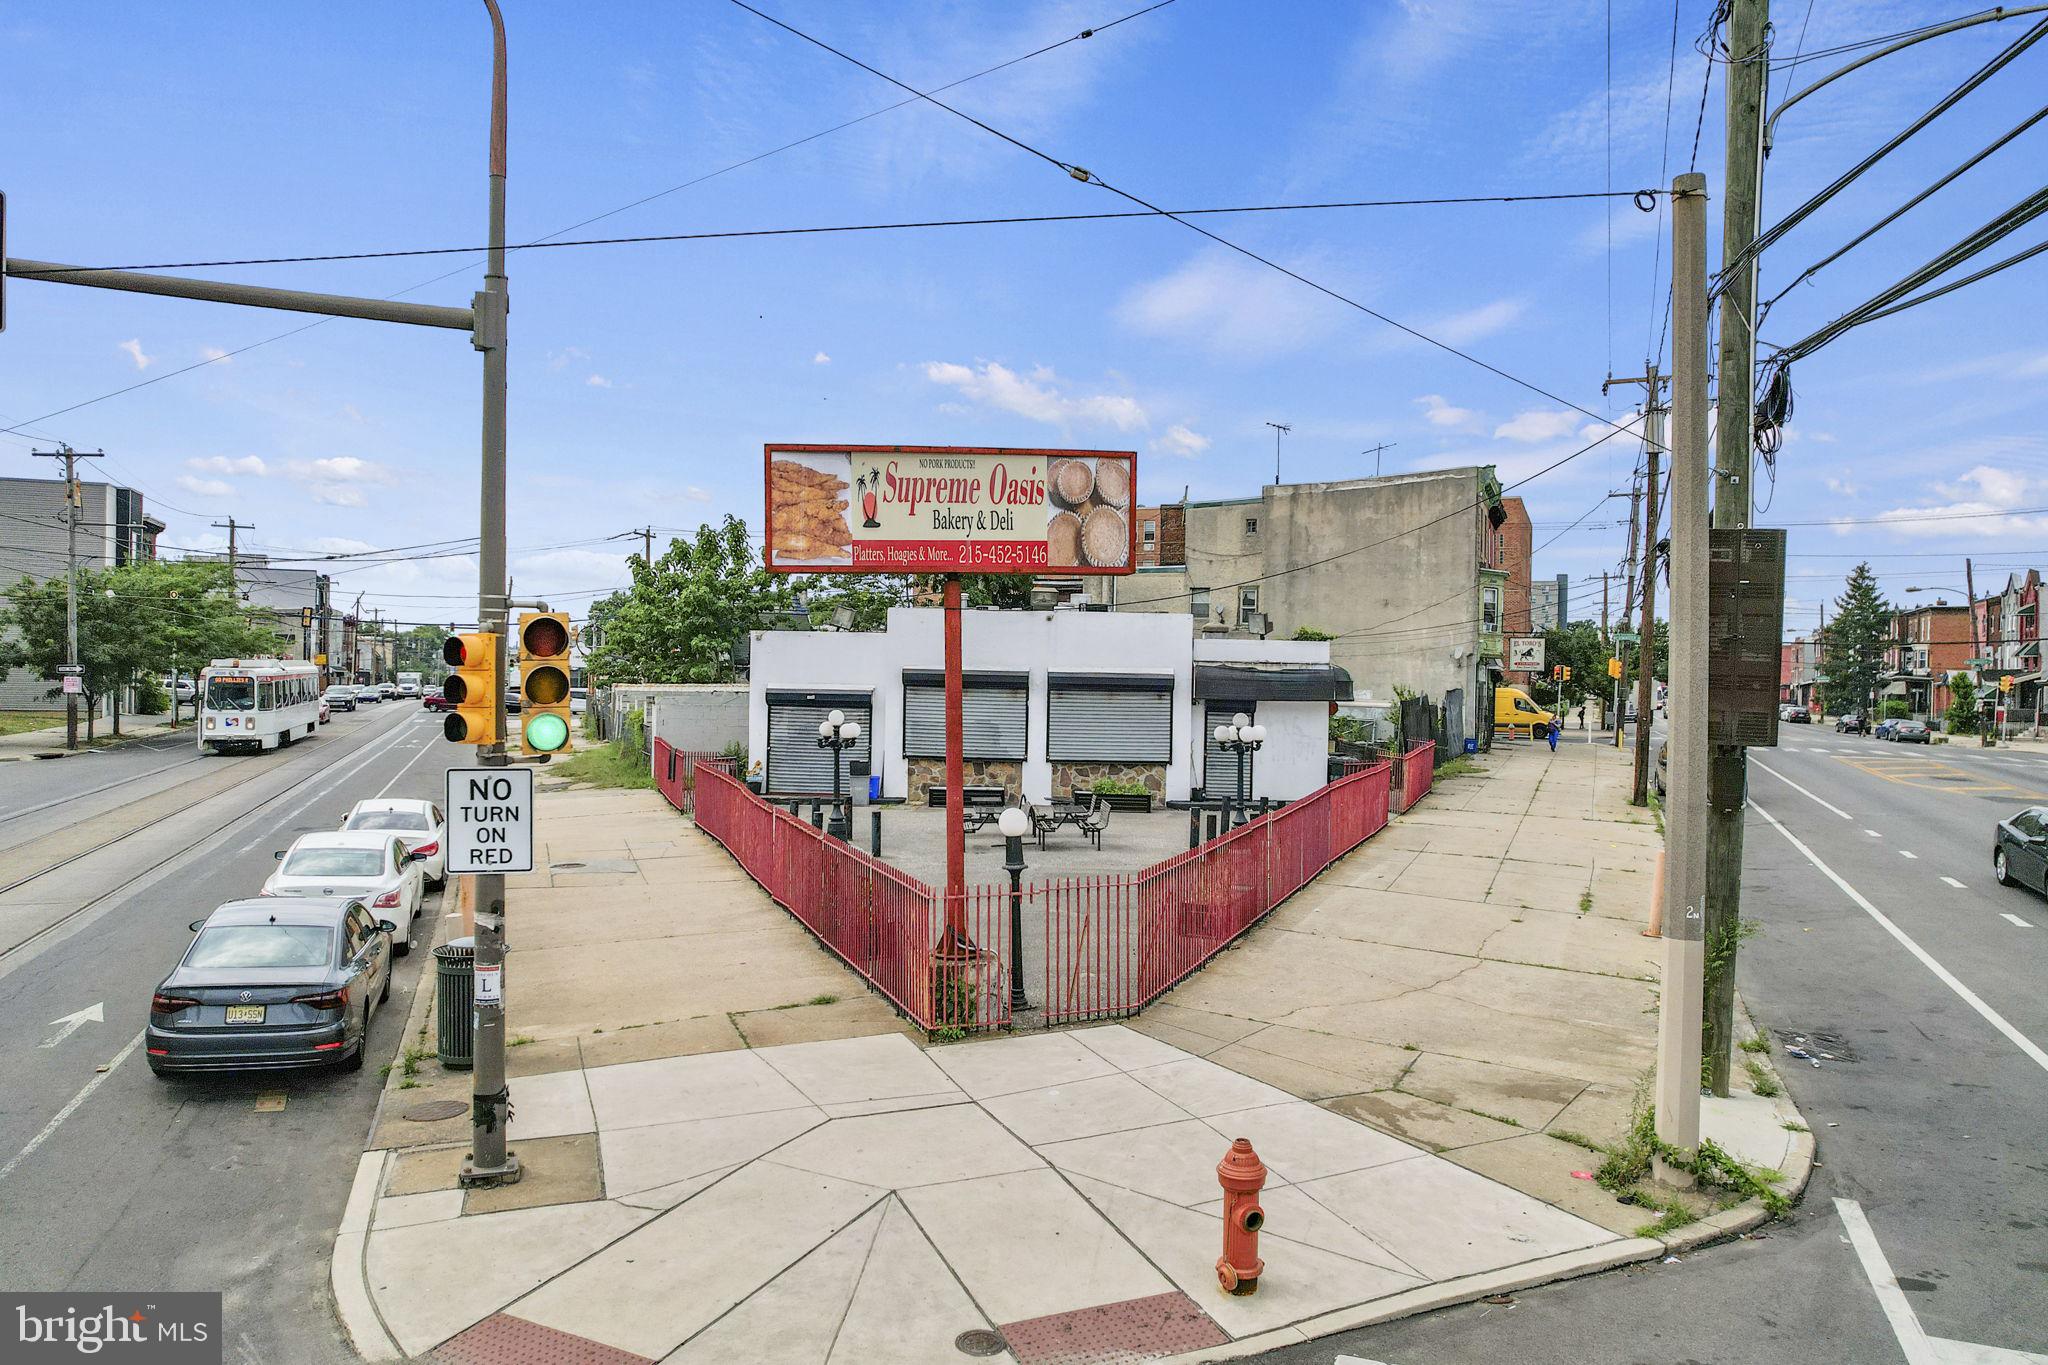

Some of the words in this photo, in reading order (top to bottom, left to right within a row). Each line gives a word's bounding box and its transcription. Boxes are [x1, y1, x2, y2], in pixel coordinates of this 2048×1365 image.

[919, 458, 928, 469] NO
[929, 458, 943, 469] PORK
[882, 460, 981, 516] Supreme
[989, 462, 1045, 506] Oasis
[932, 507, 974, 538] Bakery
[976, 509, 987, 531] &
[990, 508, 1014, 531] Deli
[853, 544, 886, 564] Platters,
[887, 545, 918, 566] Hoagies
[918, 546, 926, 561] &
[927, 546, 954, 562] More...
[958, 544, 1047, 564] 215-452-5146
[469, 778, 511, 801] NO
[460, 806, 519, 822] TURN
[476, 827, 506, 843] ON
[470, 848, 513, 865] RED
[481, 978, 492, 993] L
